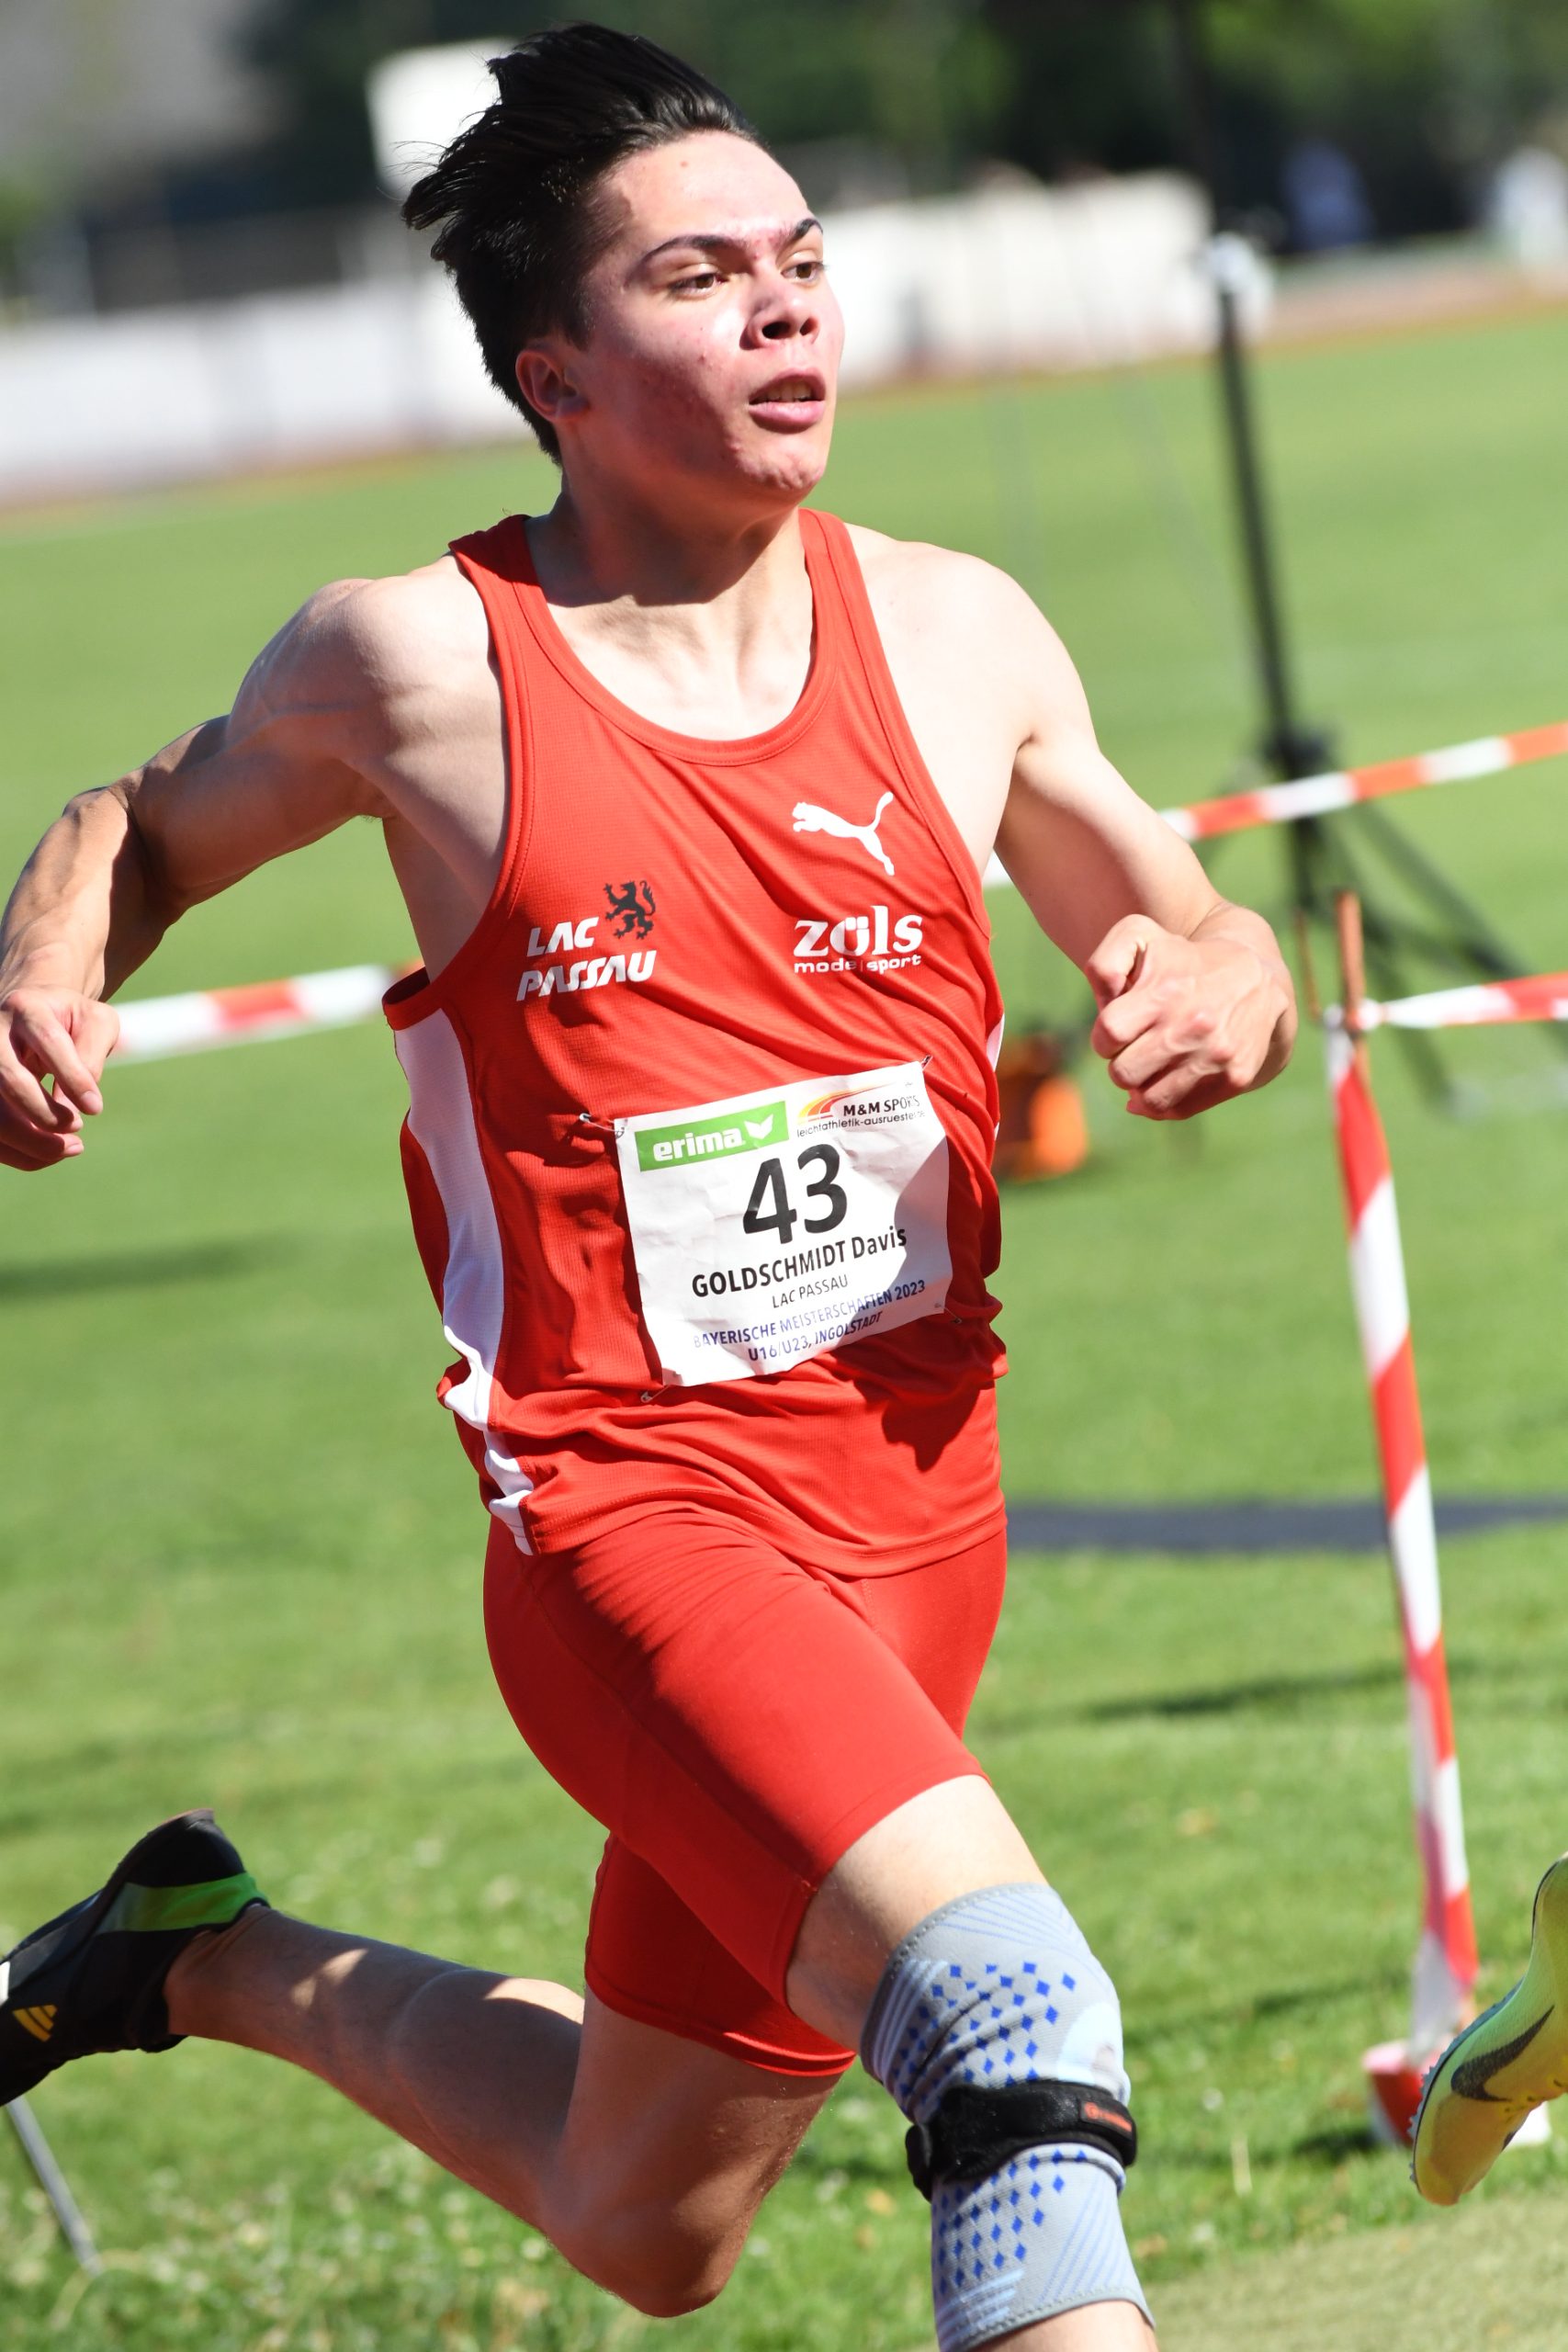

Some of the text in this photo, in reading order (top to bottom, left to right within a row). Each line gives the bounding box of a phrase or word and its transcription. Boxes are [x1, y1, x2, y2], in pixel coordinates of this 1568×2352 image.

[526, 917, 600, 957] LAC
[516, 950, 657, 1001] PASSAU
[794, 955, 921, 975] mode sport
[843, 1102, 880, 1117] M&M
[652, 1127, 742, 1162] erima
[742, 1143, 848, 1244] 43
[692, 1226, 907, 1297] GOLDSCHMIDT Davis
[773, 1274, 849, 1308] LAC PASSAU
[694, 1279, 926, 1348] BAYERISCHE MEISTERSCHAFTEN 2023
[815, 1311, 883, 1344] INGOLSTADT
